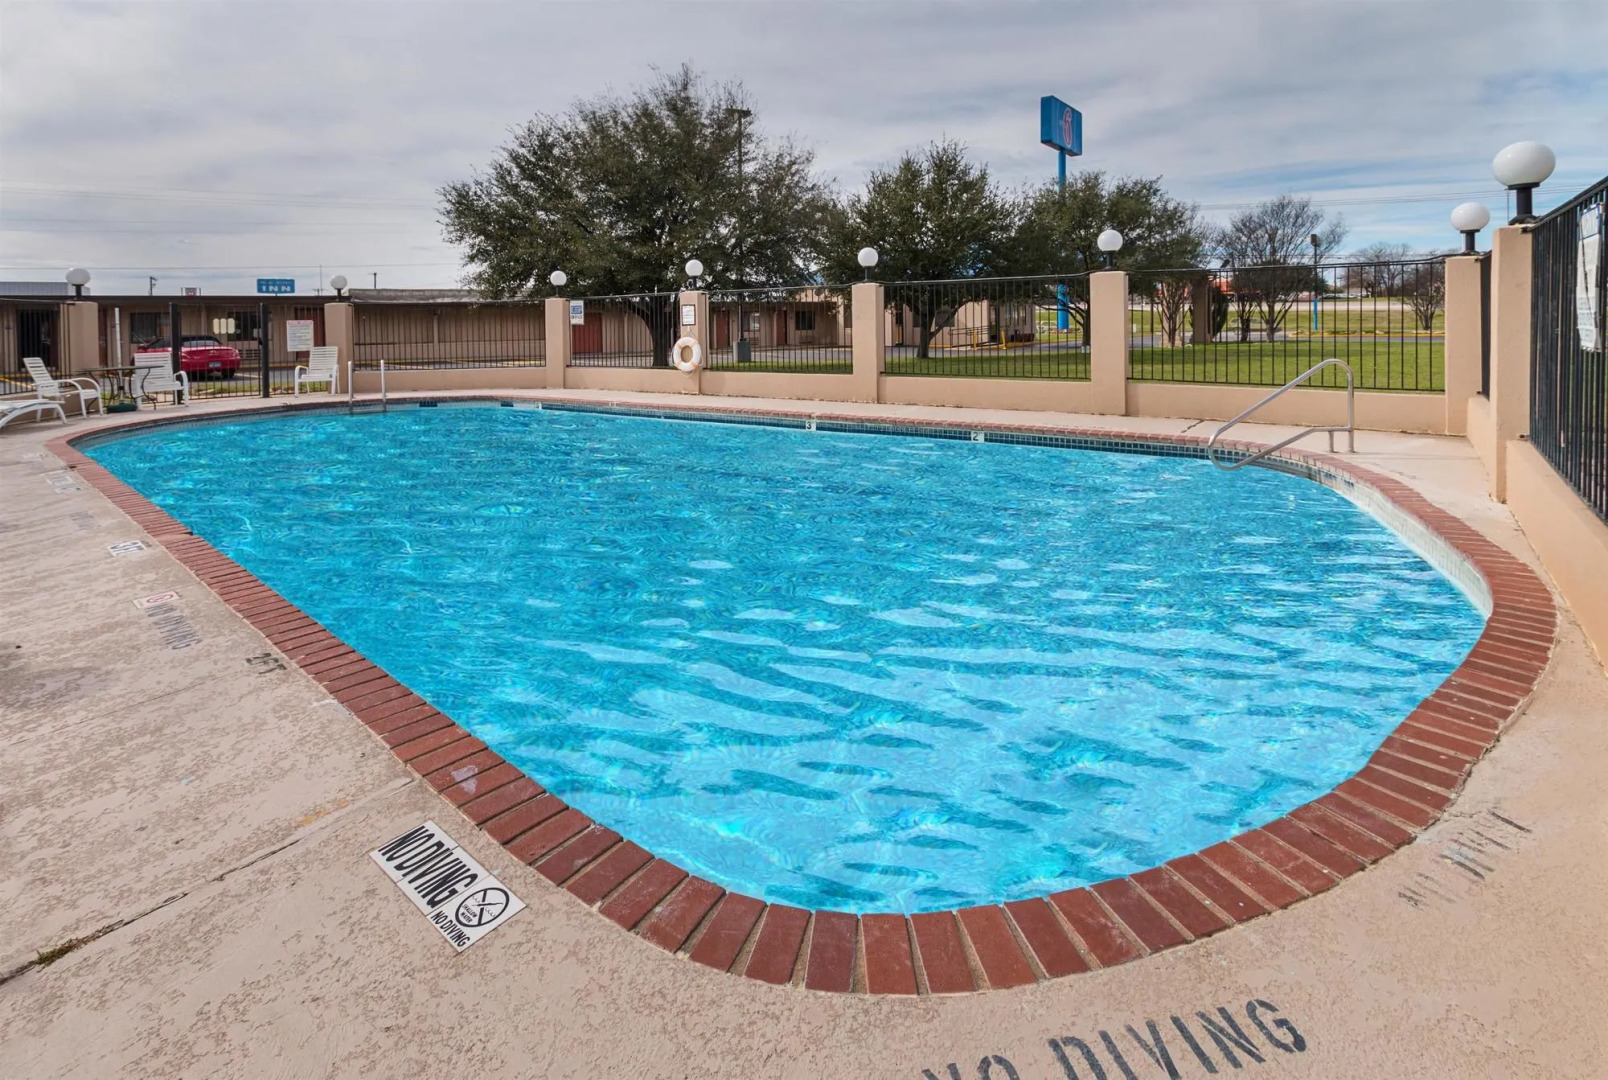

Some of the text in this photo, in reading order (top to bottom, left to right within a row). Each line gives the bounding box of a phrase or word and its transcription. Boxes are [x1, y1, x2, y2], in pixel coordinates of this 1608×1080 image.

[1063, 108, 1072, 147] 6
[378, 825, 478, 909] NO DIVING
[430, 910, 471, 947] NO DIVING
[460, 911, 473, 923] WATER
[462, 903, 478, 918] SHALLOW
[1048, 997, 1306, 1080] DIVING
